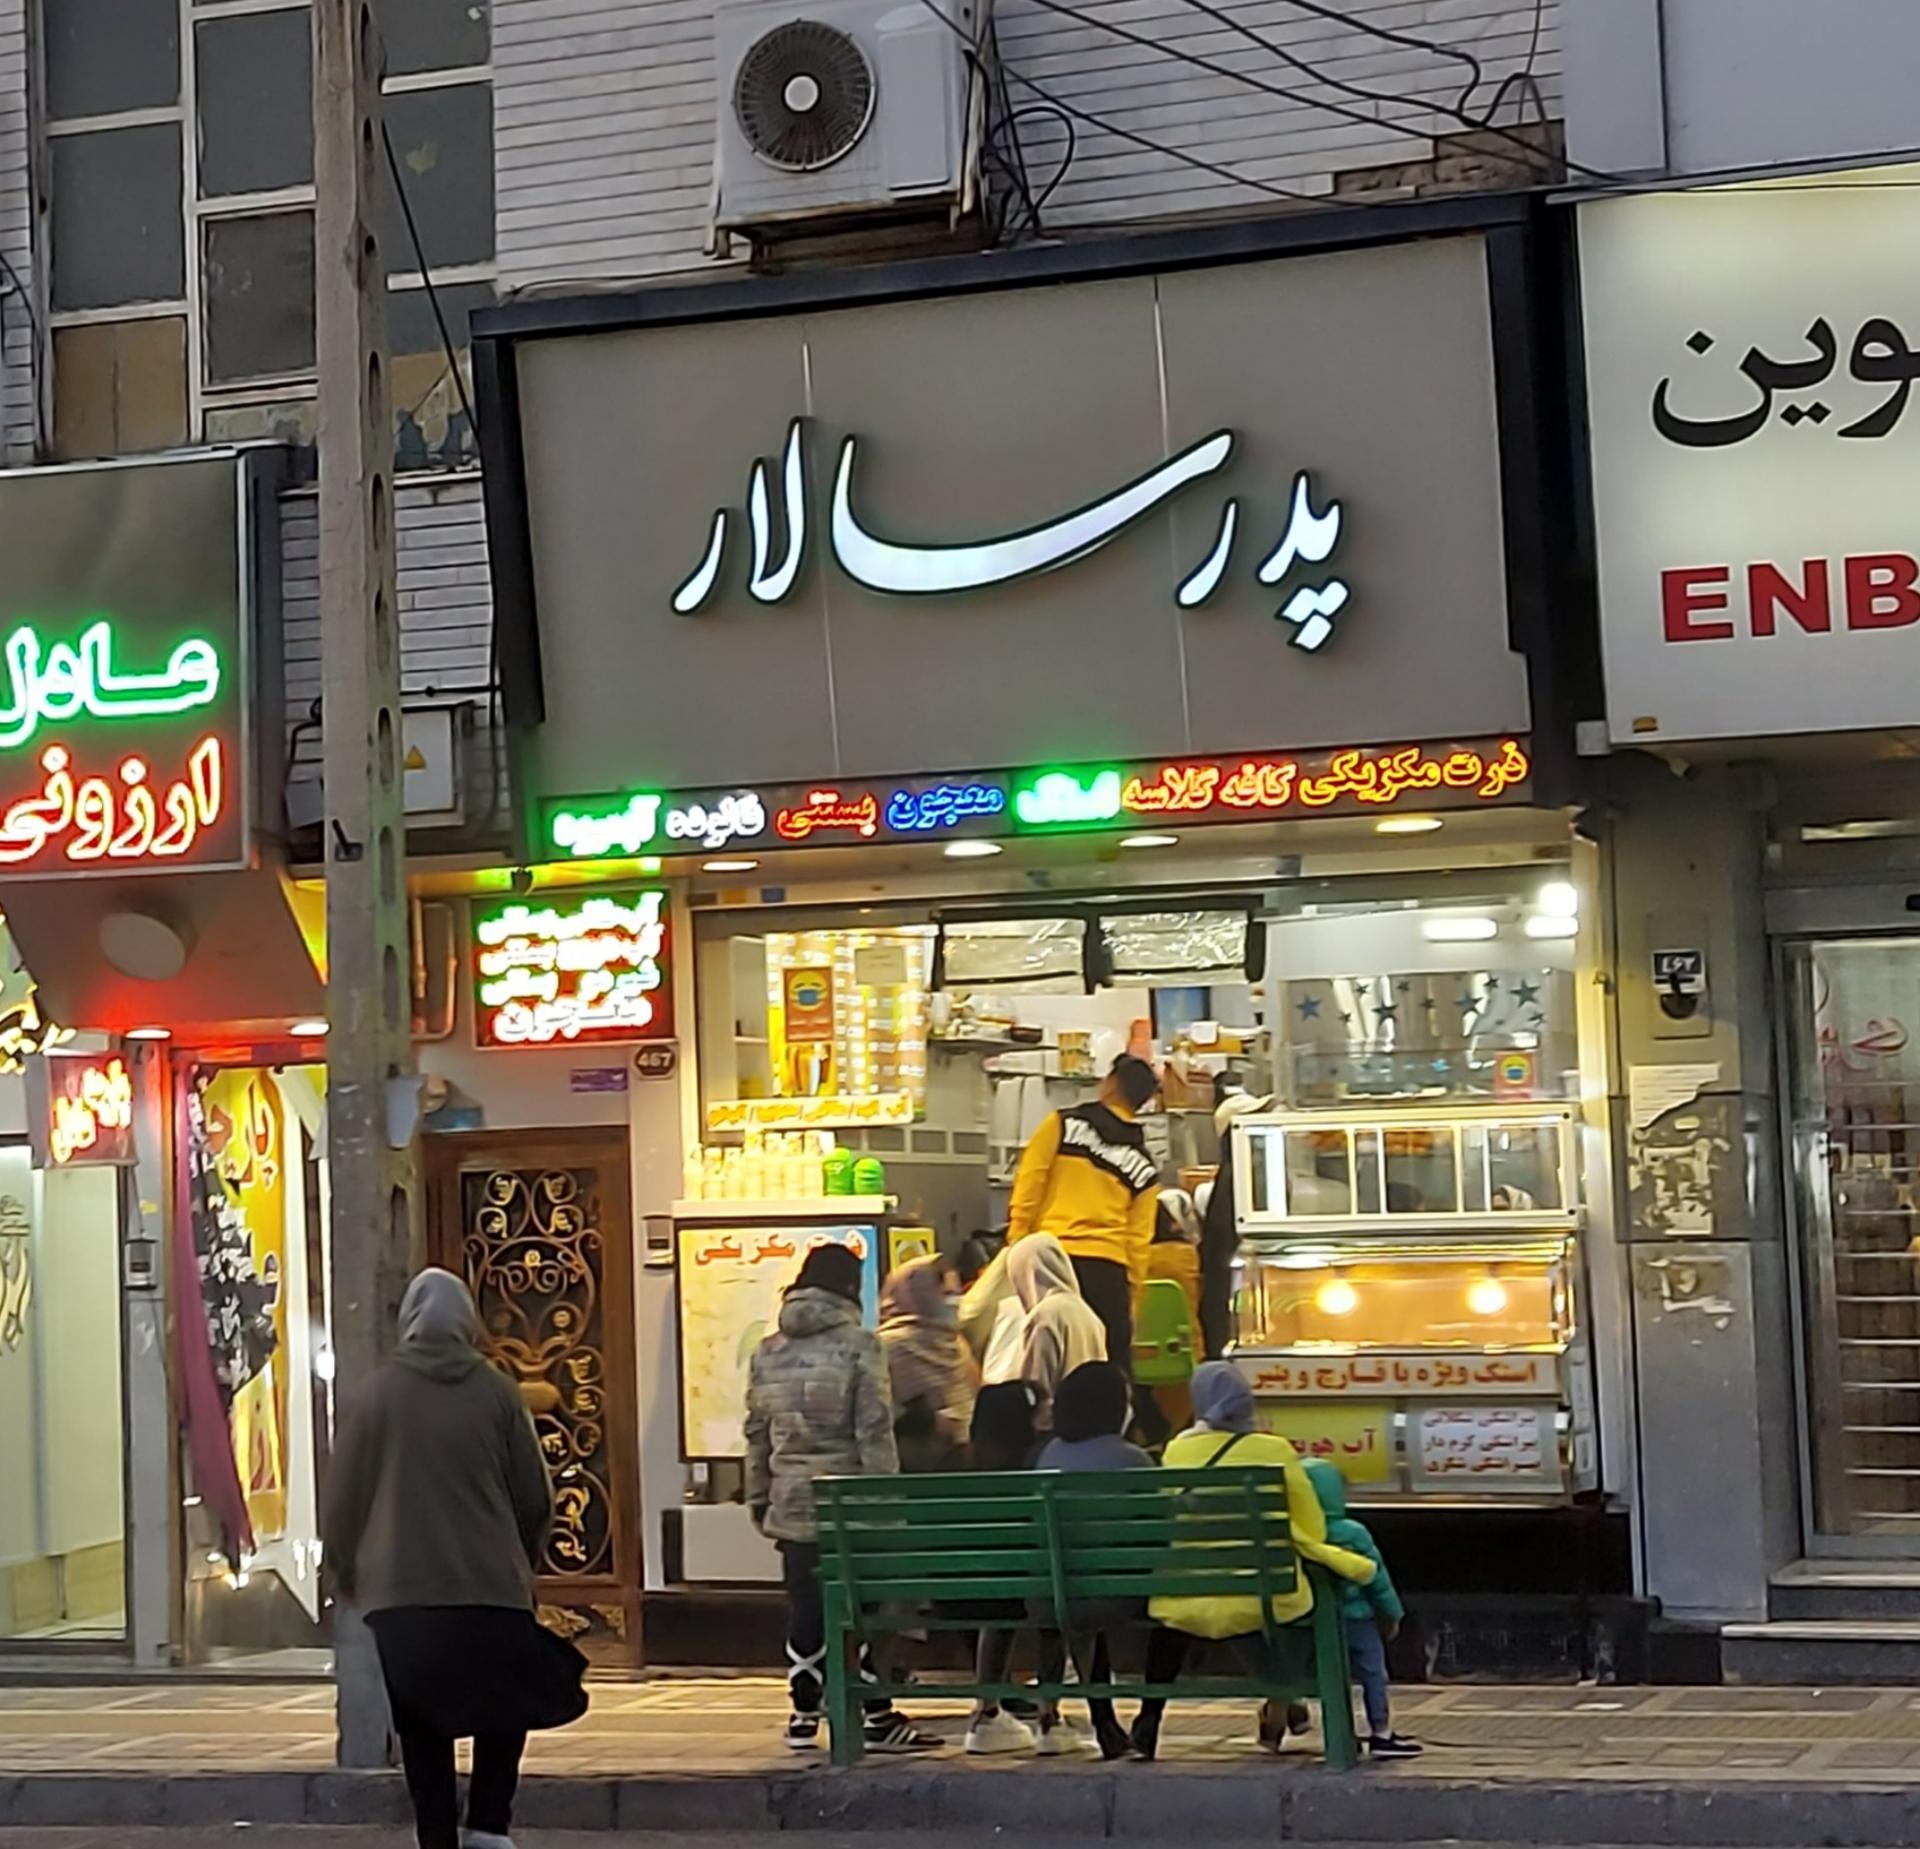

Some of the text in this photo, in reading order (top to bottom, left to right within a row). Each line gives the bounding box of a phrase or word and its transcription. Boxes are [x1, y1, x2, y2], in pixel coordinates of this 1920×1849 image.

[1653, 317, 1920, 447] وین
[1300, 748, 1441, 805] مکزیکی
[1441, 740, 1528, 796] ذرت
[665, 793, 765, 848] فالوده
[777, 790, 877, 837] بستنی
[887, 785, 1004, 829] معجون
[695, 1233, 796, 1266] مکزیکی
[1296, 1369, 1309, 1390] و
[1315, 1360, 1387, 1389] قارچ
[1393, 1361, 1410, 1388] با
[1417, 1361, 1469, 1388] ویژه
